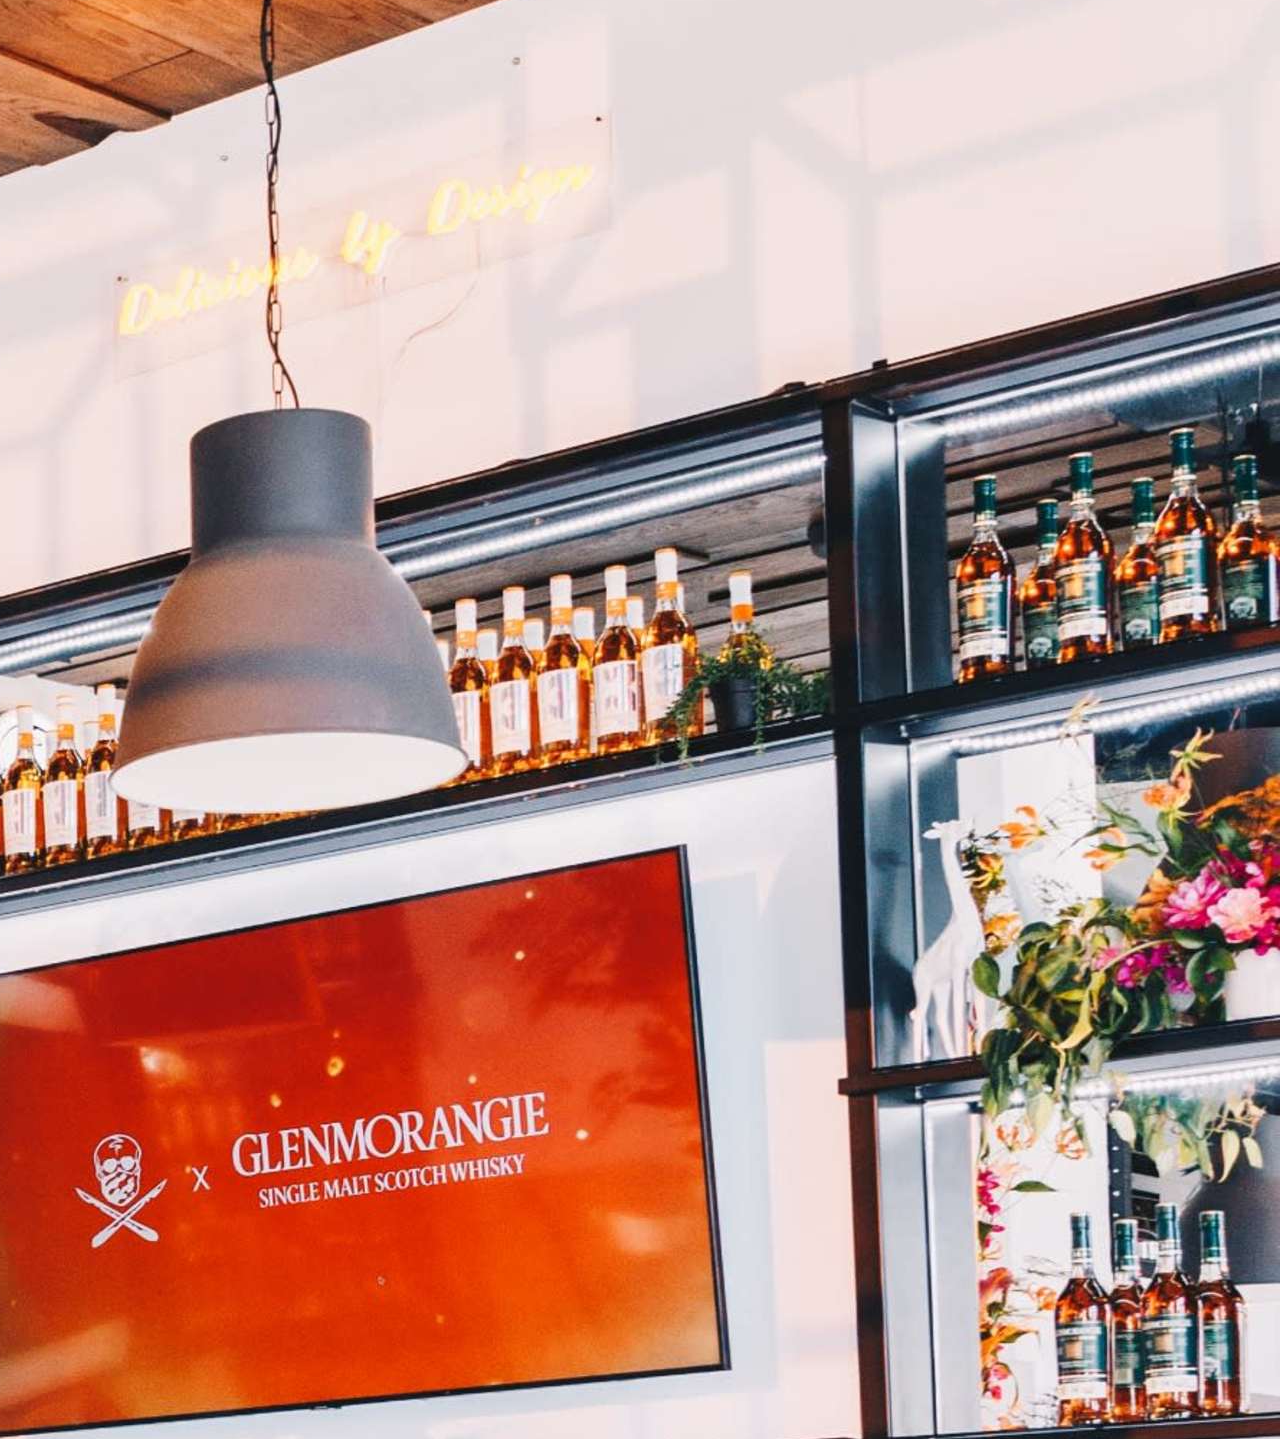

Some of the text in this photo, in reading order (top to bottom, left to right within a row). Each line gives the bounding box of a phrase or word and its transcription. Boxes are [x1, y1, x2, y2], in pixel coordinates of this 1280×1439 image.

[427, 161, 596, 235] Design
[231, 1091, 551, 1178] GLENMORANGIE
[257, 1152, 527, 1209] SINGLE MALT SCOTCH WHISKY
